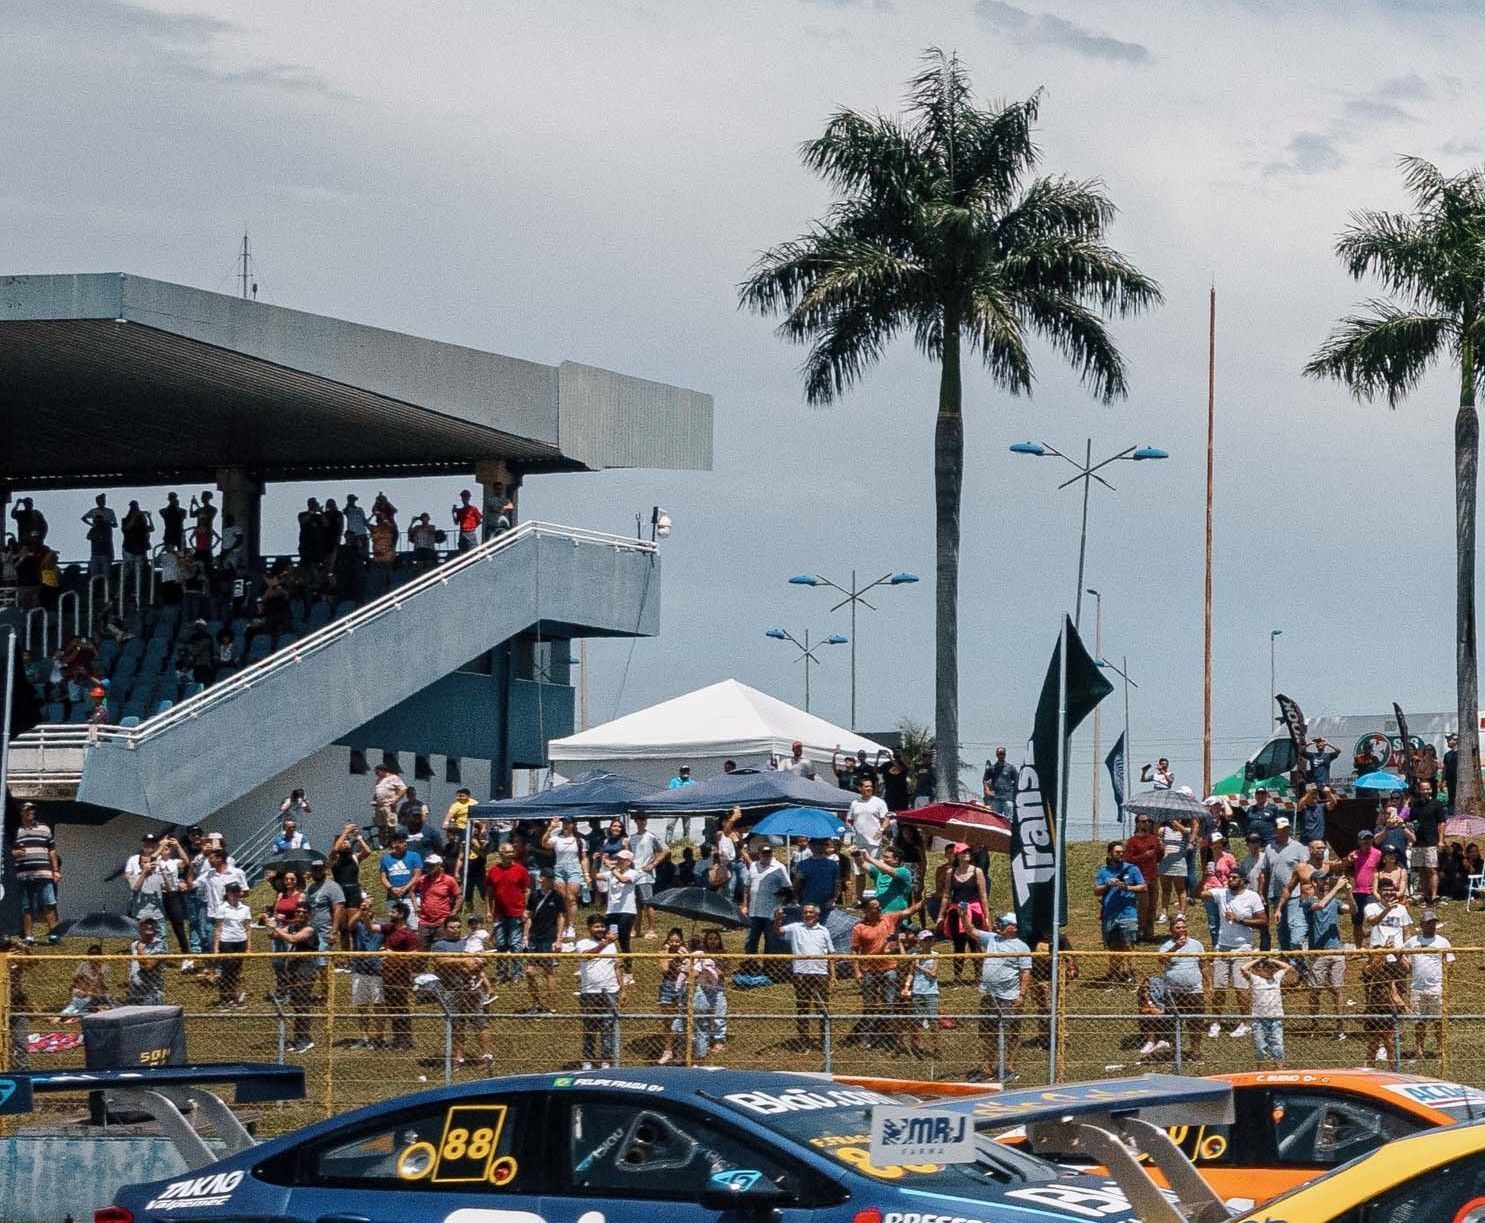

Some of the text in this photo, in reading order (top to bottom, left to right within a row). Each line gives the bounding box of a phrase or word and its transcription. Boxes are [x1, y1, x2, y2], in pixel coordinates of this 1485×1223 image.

[573, 1078, 611, 1087] FELIPE
[610, 1080, 648, 1090] FRAGA
[442, 1127, 494, 1161] 88
